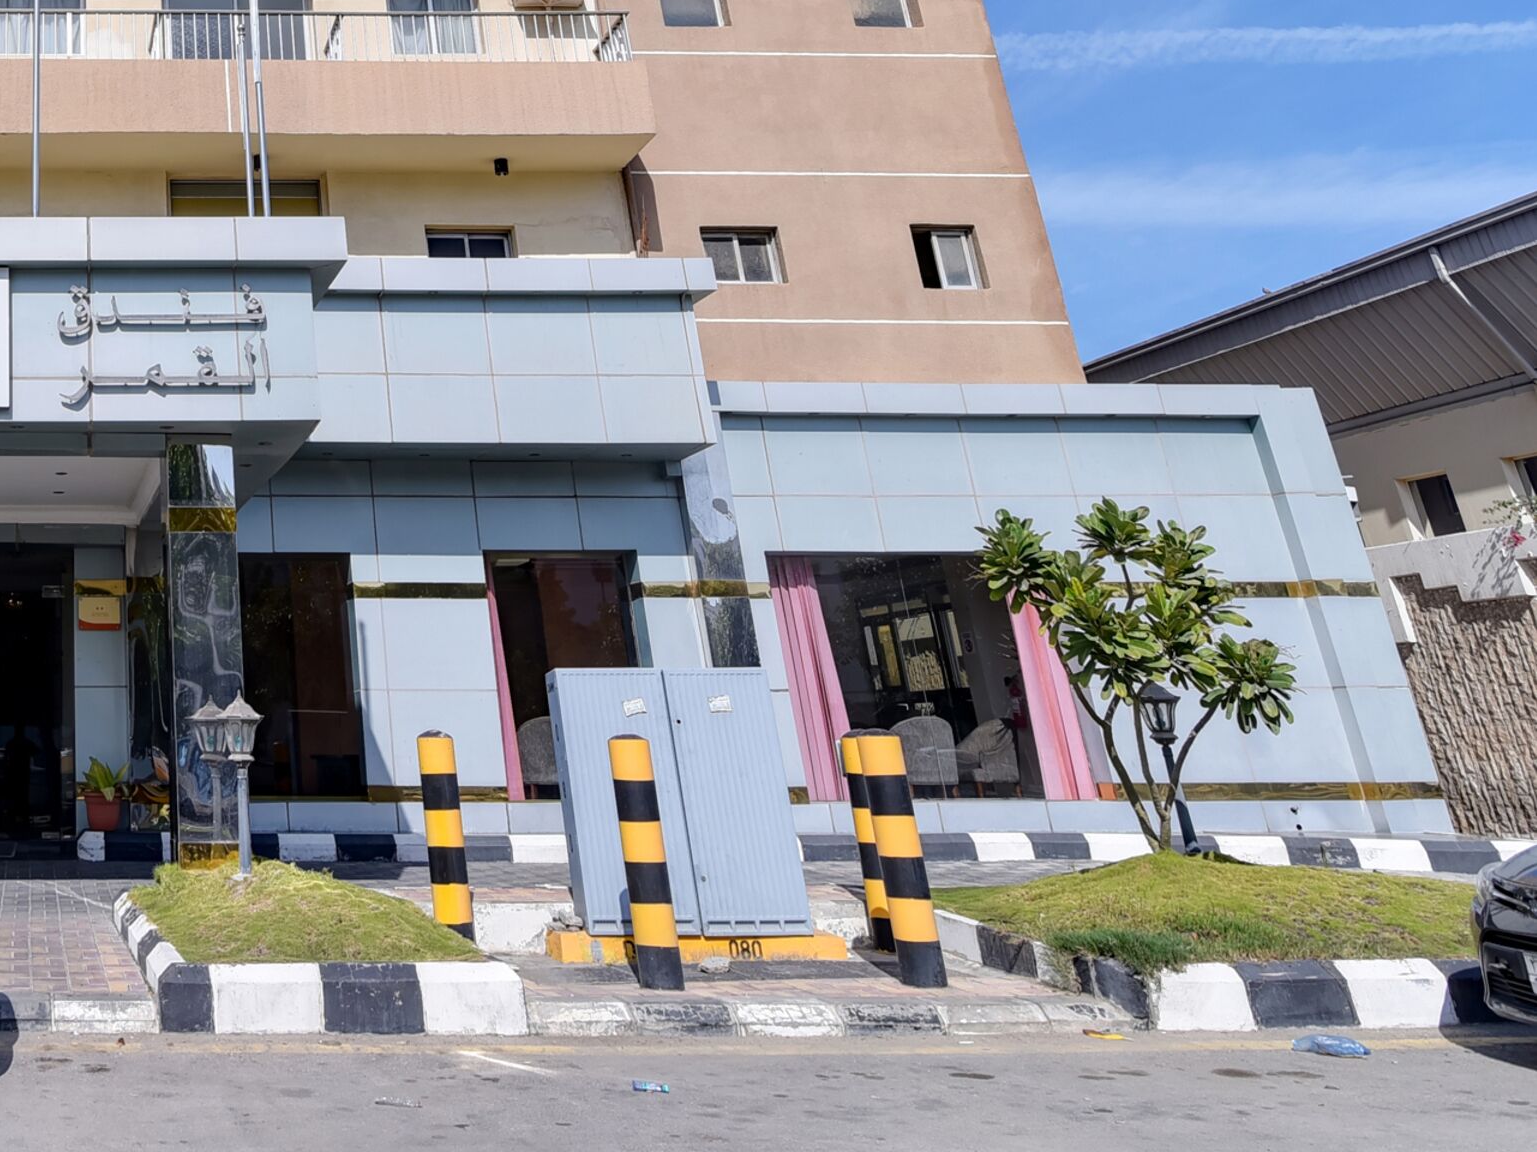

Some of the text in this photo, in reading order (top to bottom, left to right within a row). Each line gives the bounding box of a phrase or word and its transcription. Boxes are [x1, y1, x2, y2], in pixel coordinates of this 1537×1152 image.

[57, 282, 267, 335] فندق
[59, 336, 271, 404] القمر
[728, 938, 763, 960] 080
